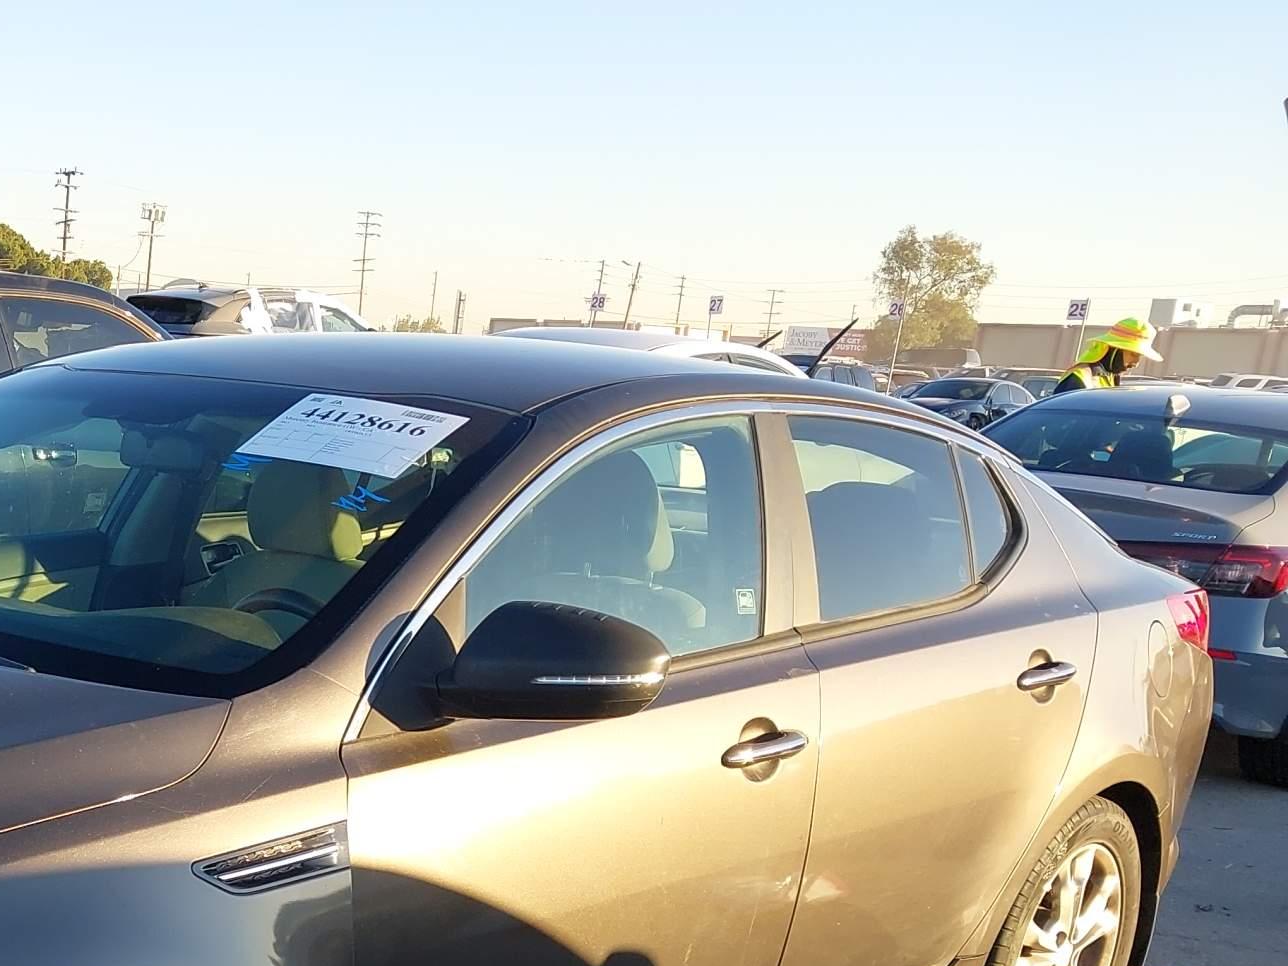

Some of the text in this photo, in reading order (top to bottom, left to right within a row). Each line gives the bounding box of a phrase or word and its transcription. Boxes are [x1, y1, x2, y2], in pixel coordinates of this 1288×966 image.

[591, 296, 606, 309] 28
[709, 298, 723, 312] 27
[1068, 303, 1087, 317] 25
[300, 407, 432, 437] 44128616
